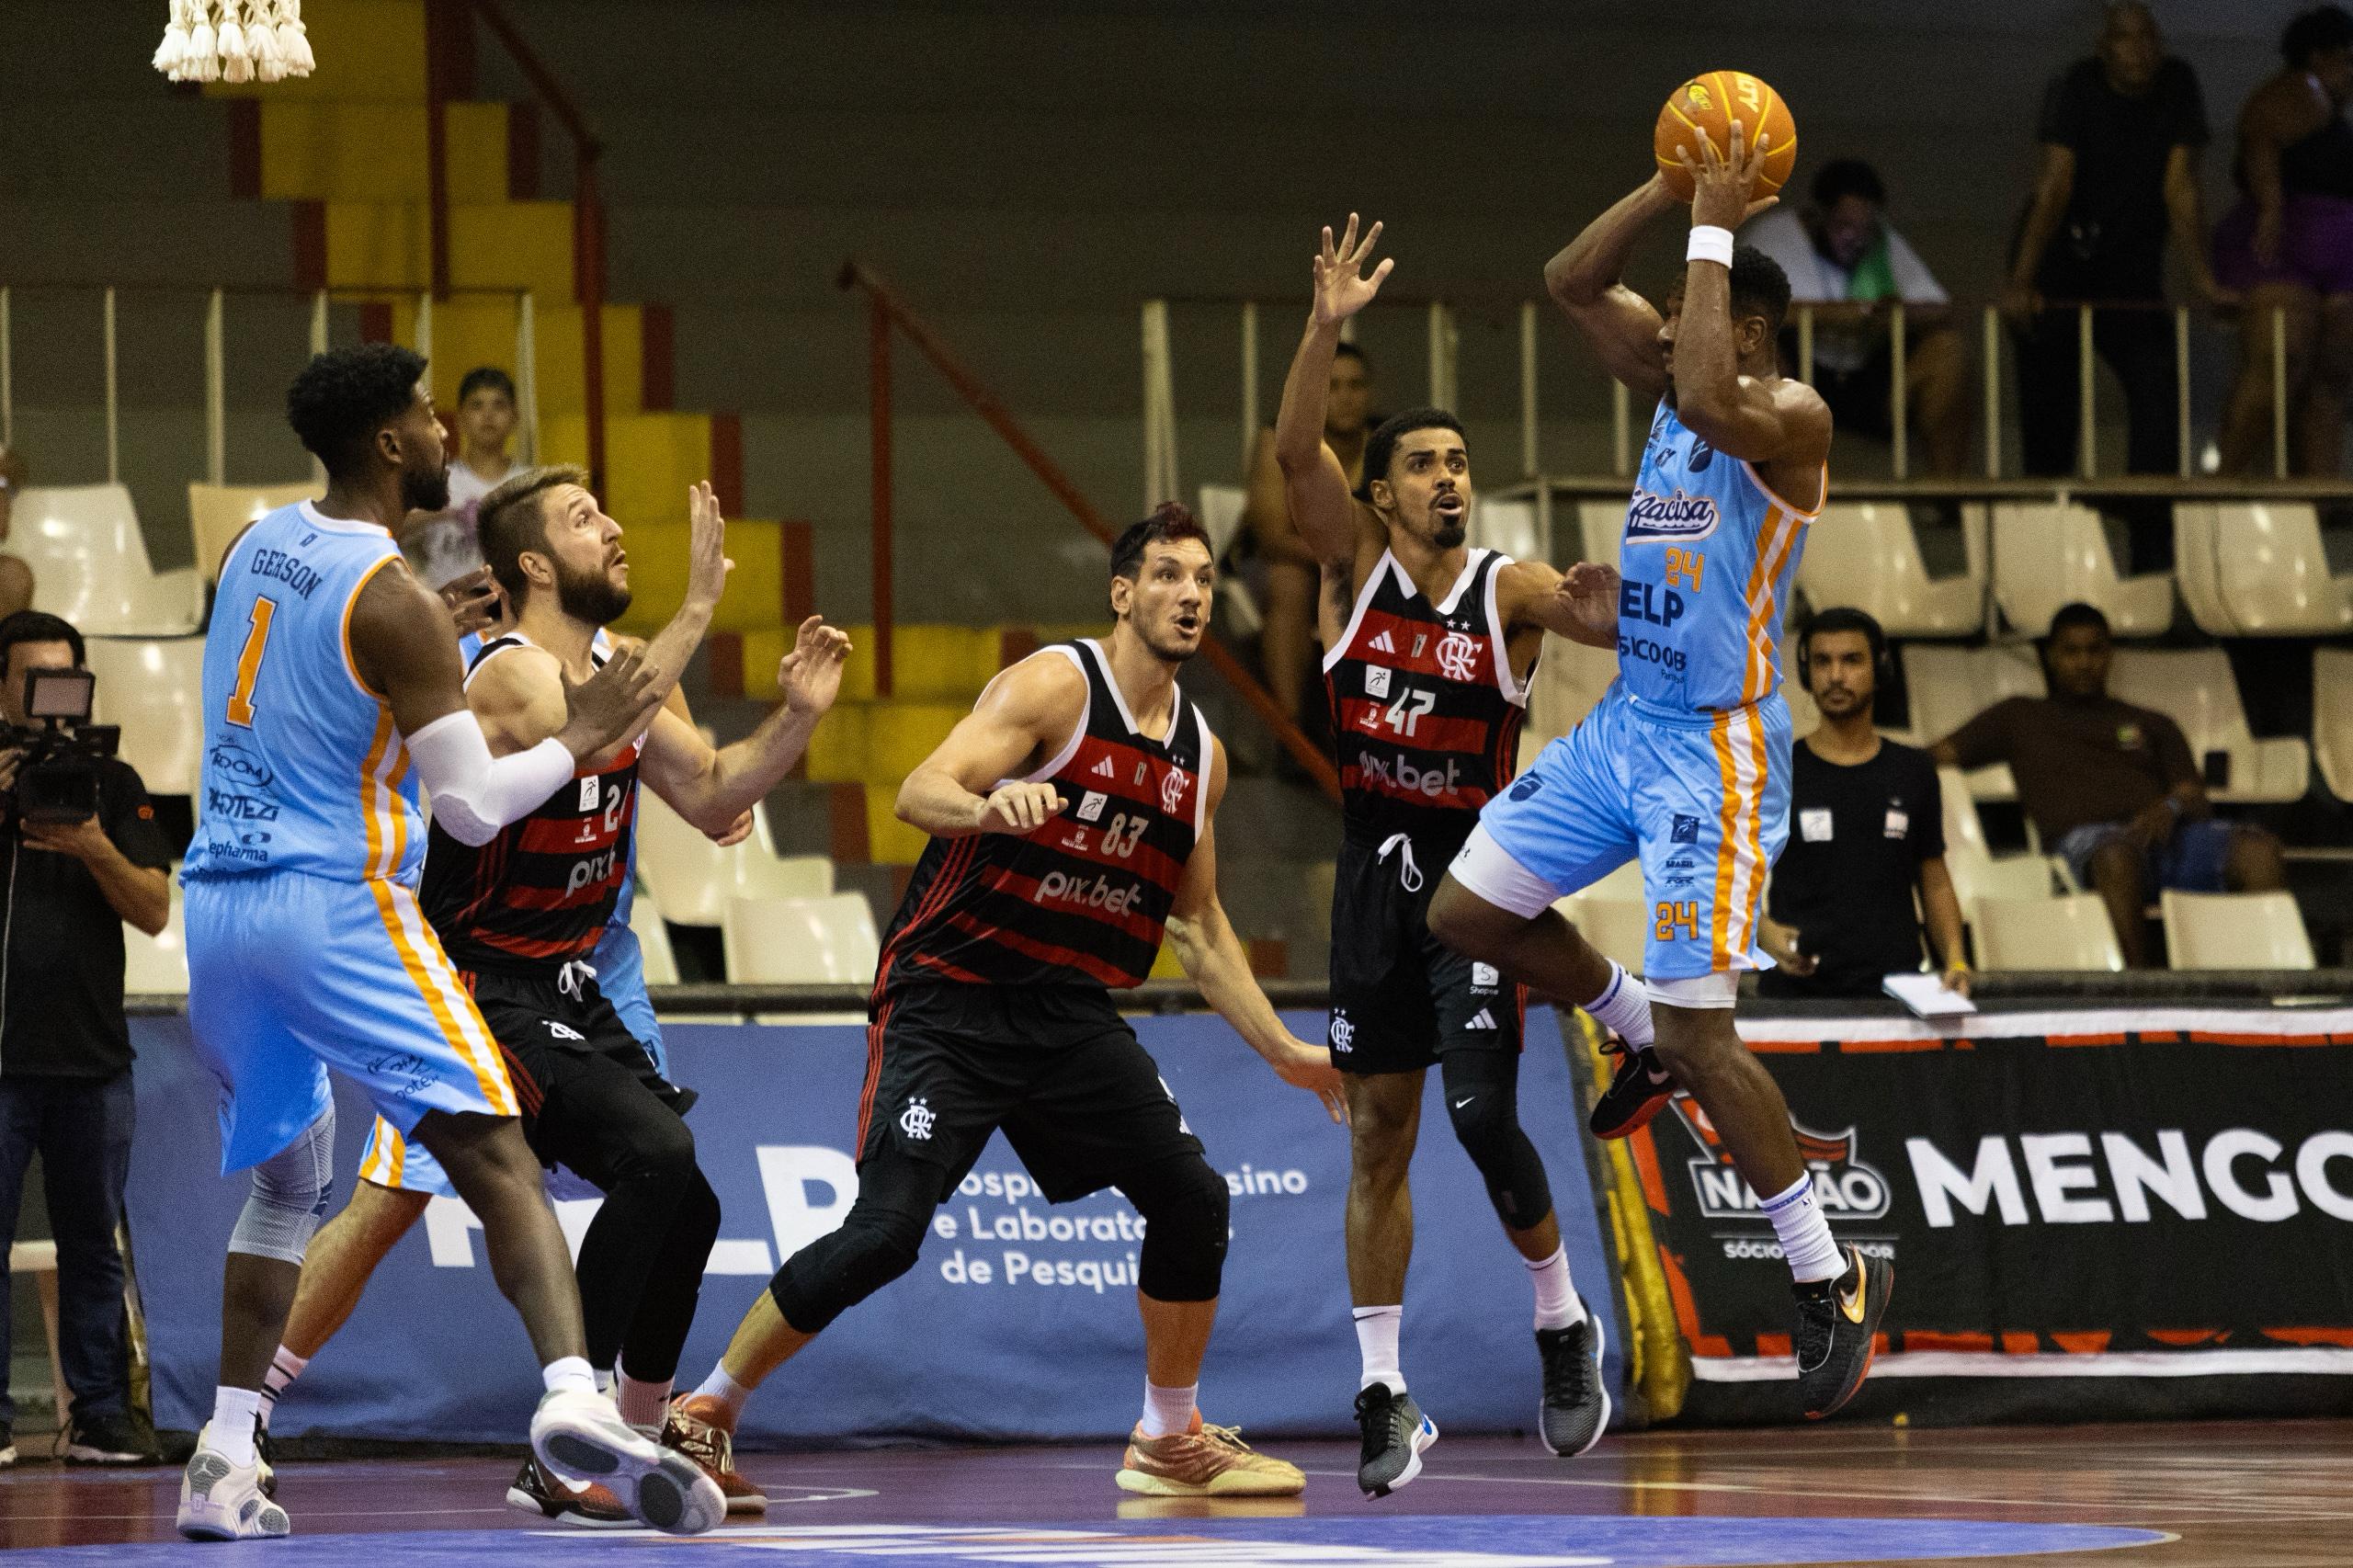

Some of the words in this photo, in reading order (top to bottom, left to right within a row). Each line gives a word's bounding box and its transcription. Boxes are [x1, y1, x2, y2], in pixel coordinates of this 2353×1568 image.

[251, 548, 321, 601] GERSON
[1665, 547, 1704, 593] 24
[1620, 579, 1684, 629] ELP
[225, 594, 278, 730] 1
[1619, 636, 1687, 671] SICOOB
[1384, 687, 1436, 737] 47
[209, 838, 268, 862] epharma
[1101, 813, 1149, 858] 83
[1034, 871, 1142, 917] pix.bet
[1655, 902, 1699, 941] 24
[1224, 1164, 1307, 1196] sino
[1700, 1162, 1882, 1211] NÃO
[934, 1214, 957, 1239] e
[969, 1207, 1147, 1241] Laborat
[940, 1250, 992, 1285] de
[1003, 1251, 1140, 1294] Pesqui
